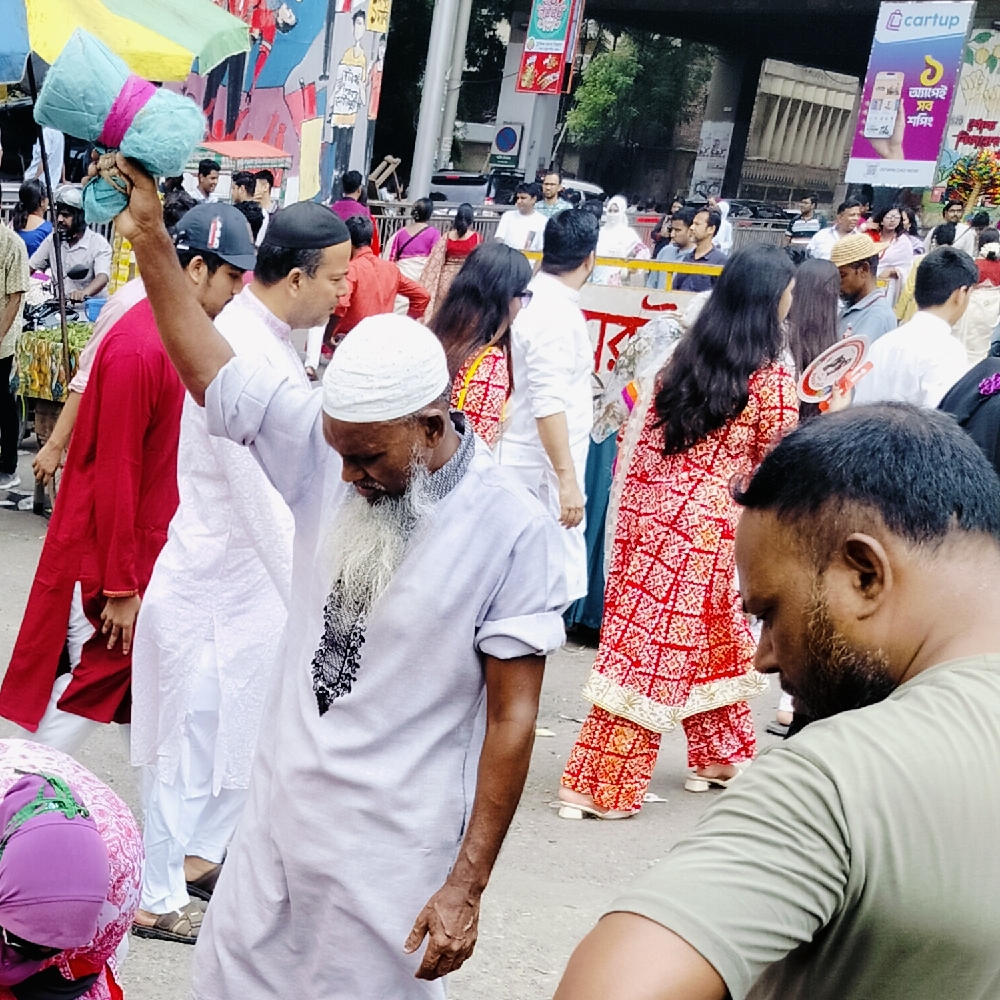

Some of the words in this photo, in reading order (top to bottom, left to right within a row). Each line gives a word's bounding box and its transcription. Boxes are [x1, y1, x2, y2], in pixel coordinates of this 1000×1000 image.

[904, 13, 960, 30] cartup
[920, 54, 944, 87] ১
[908, 85, 948, 100] অ্যাপেই
[916, 100, 934, 112] সব
[907, 112, 934, 127] শপিং
